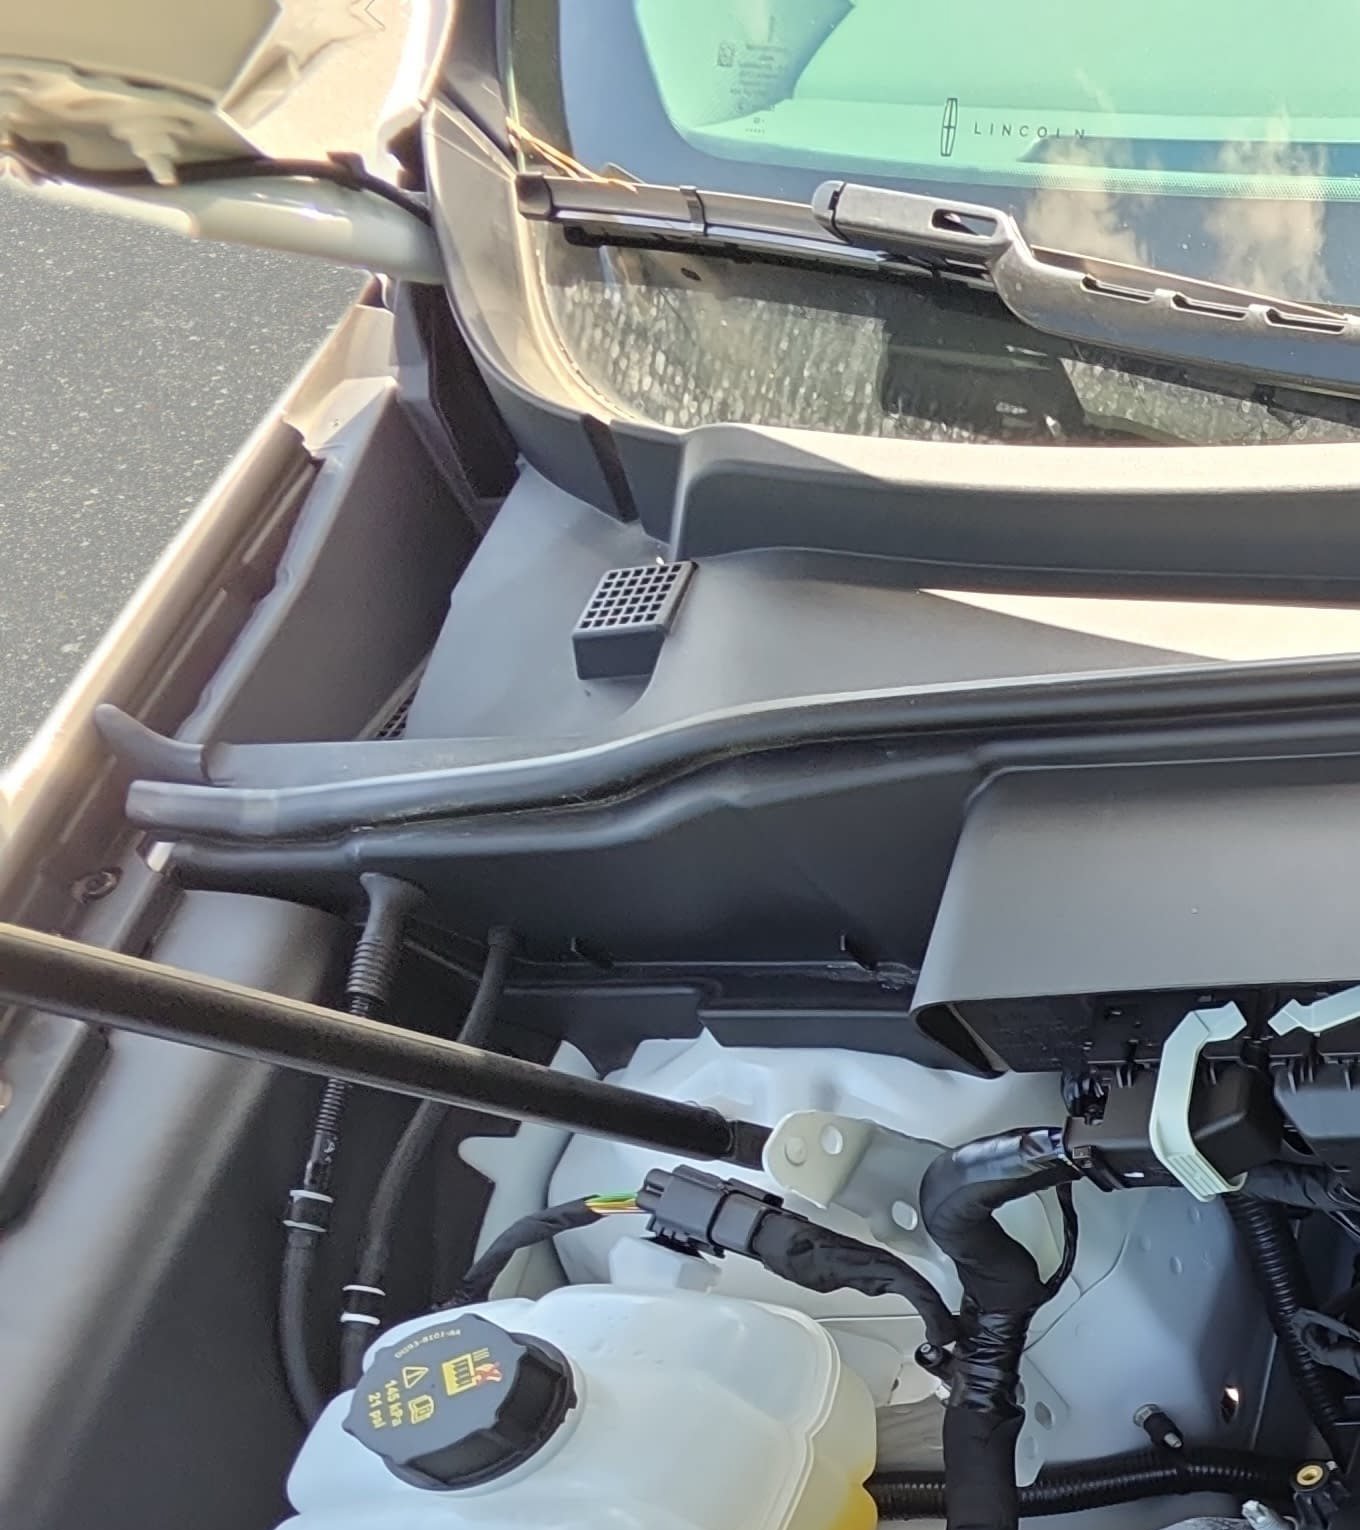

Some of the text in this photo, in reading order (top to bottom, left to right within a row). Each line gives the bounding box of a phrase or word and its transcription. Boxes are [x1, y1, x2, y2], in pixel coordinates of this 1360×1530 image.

[973, 121, 1086, 140] LINCOLN
[367, 1391, 386, 1428] 21 psi
[384, 1378, 403, 1427] 145 kPa
